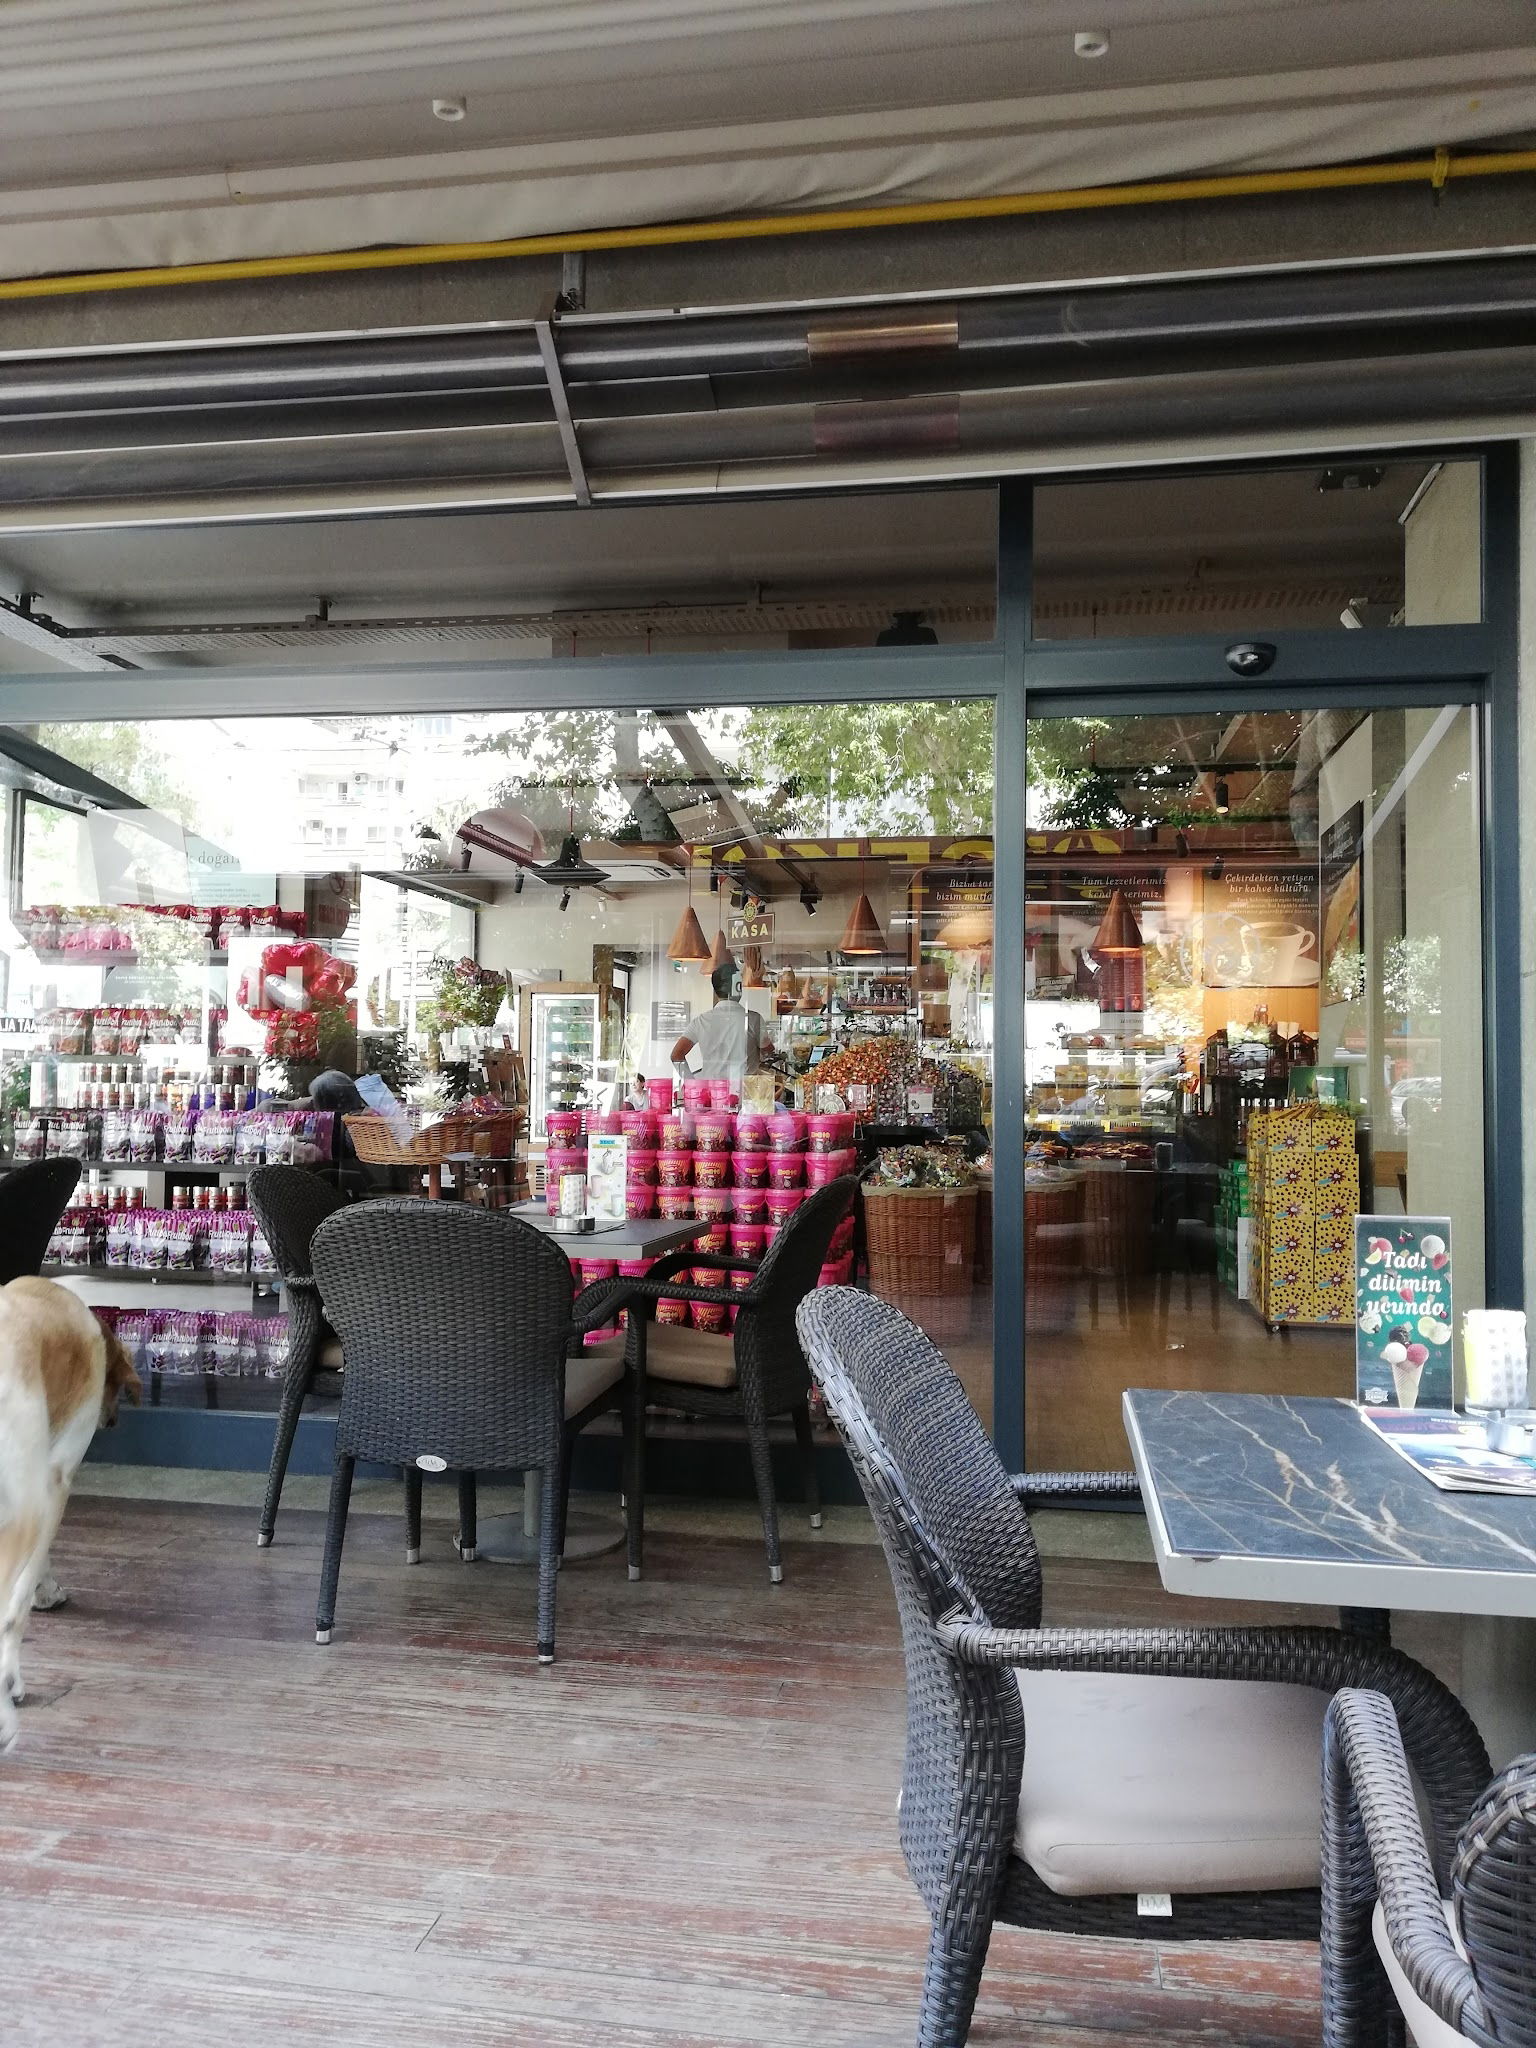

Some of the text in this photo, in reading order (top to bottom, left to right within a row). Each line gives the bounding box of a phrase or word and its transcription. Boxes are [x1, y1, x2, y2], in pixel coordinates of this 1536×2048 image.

[1225, 873, 1314, 885] Çekirdekten yetişen
[936, 891, 961, 901] bizim
[1230, 884, 1244, 893] bir
[1245, 884, 1272, 893] kahve
[731, 923, 769, 939] KASA
[1383, 1251, 1427, 1269] Tadı
[1368, 1275, 1442, 1293] dilimin
[1366, 1300, 1445, 1317] ucunda
